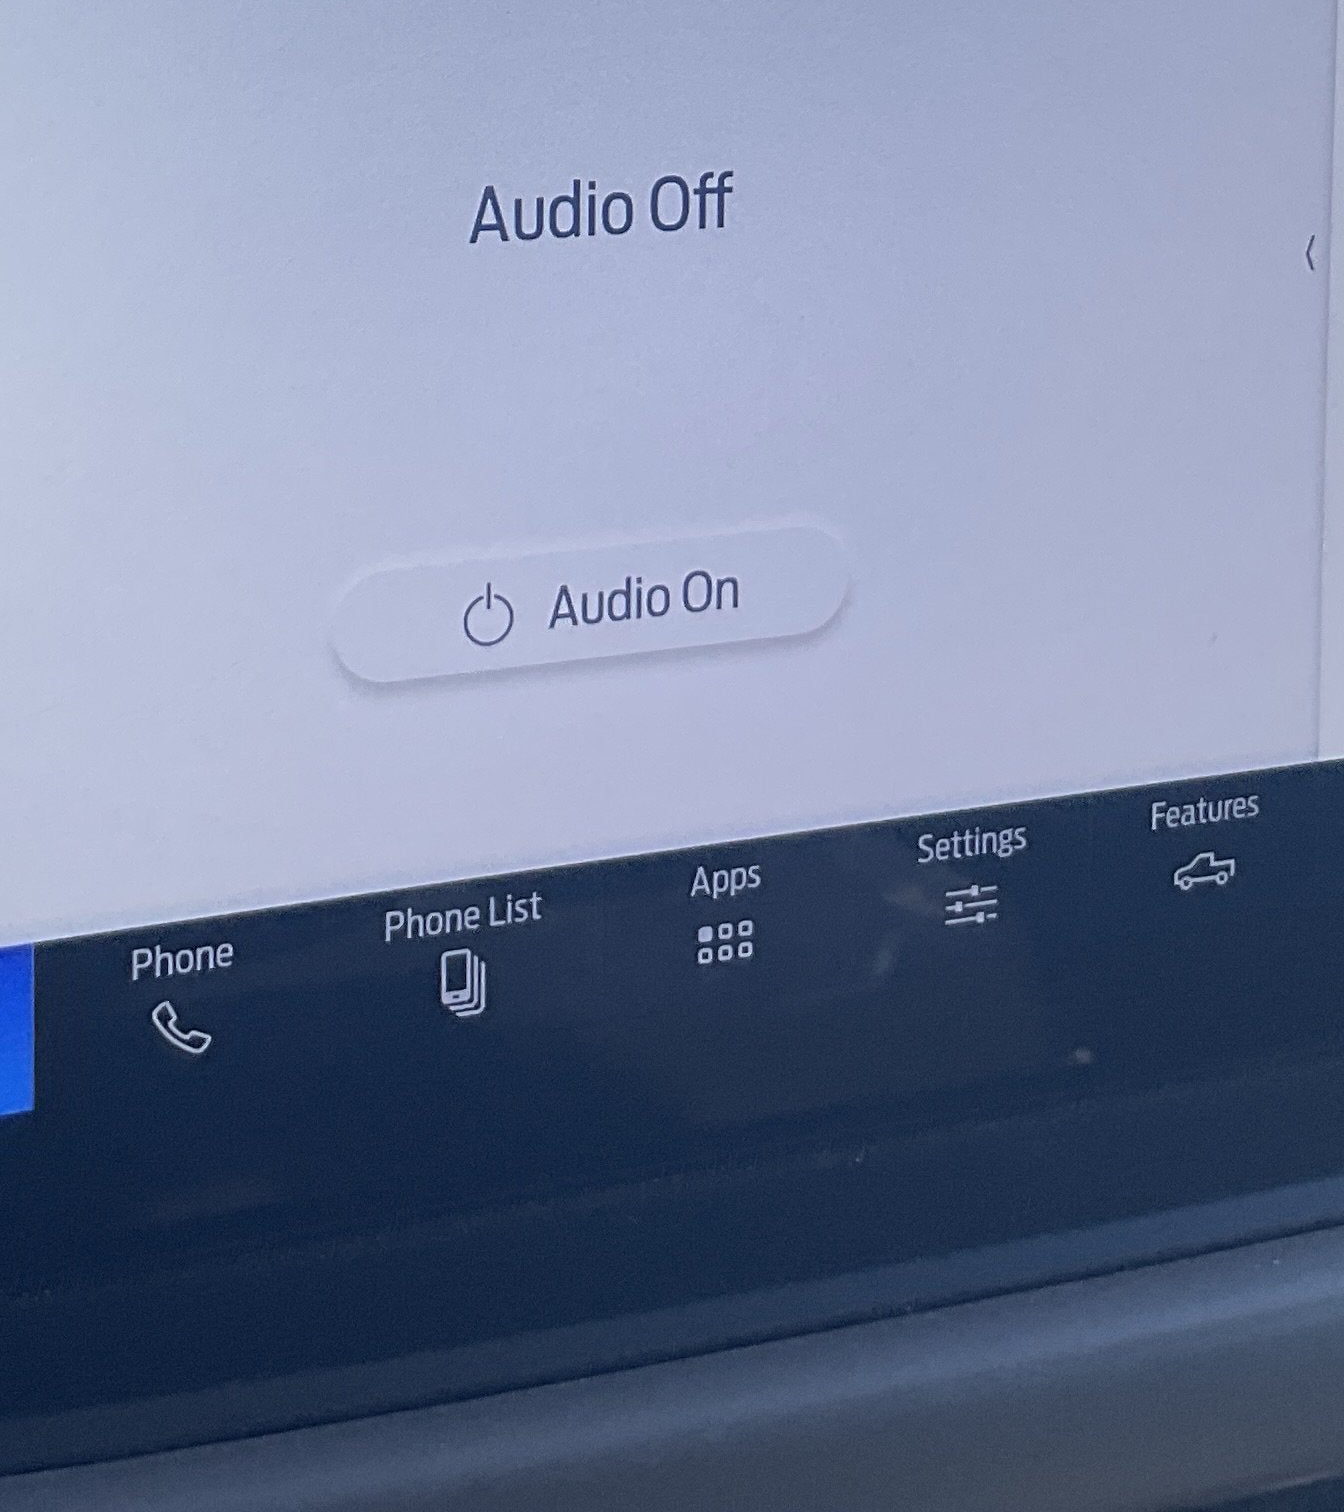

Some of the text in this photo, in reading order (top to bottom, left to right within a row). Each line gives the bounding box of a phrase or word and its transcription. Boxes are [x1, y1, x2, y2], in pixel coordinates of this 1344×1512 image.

[468, 169, 735, 244] Audio Off
[548, 569, 740, 630] Audio On
[1150, 793, 1260, 832] Features
[916, 823, 1028, 865] Settings
[689, 863, 762, 901] Apps
[384, 891, 543, 943] Phone List
[131, 941, 235, 982] Phone
